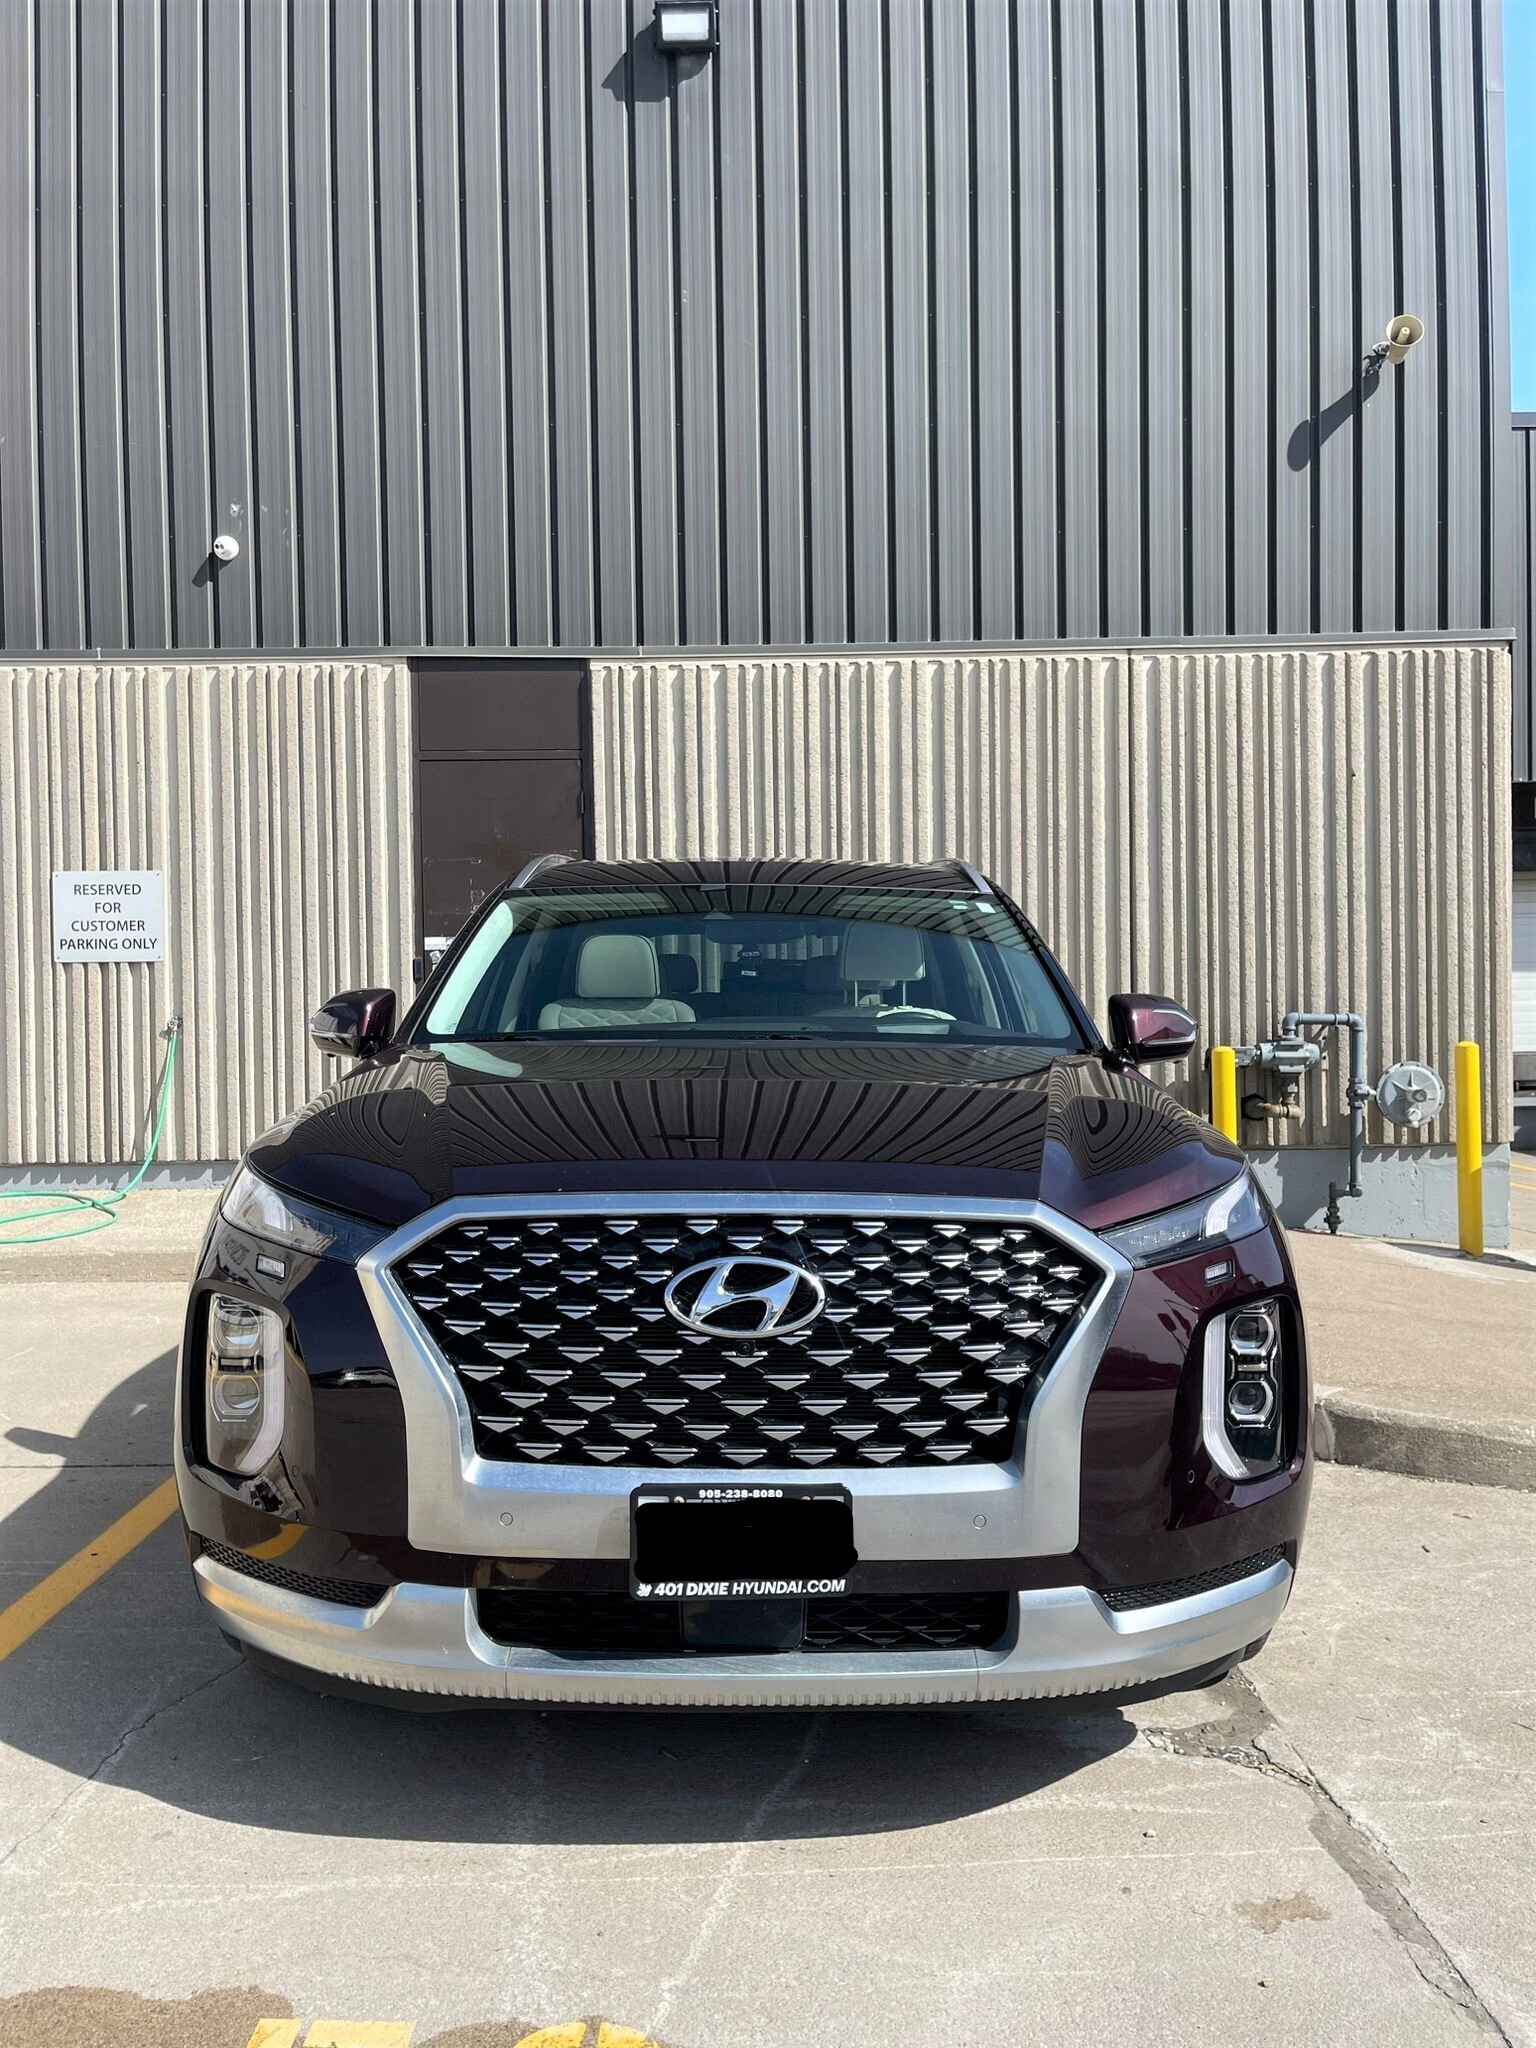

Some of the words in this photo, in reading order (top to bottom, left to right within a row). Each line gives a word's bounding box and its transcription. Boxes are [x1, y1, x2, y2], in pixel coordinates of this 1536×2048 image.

[73, 884, 142, 896] RESERVED
[94, 902, 122, 913] FOR
[71, 920, 146, 932] CUSTOMER
[60, 938, 119, 950] PARKING
[121, 938, 158, 950] ONLY
[698, 1489, 784, 1498] 905-238-8080
[654, 1582, 684, 1596] 401
[686, 1582, 729, 1596] DIXIE
[732, 1579, 846, 1595] HYUNDAI.COM
